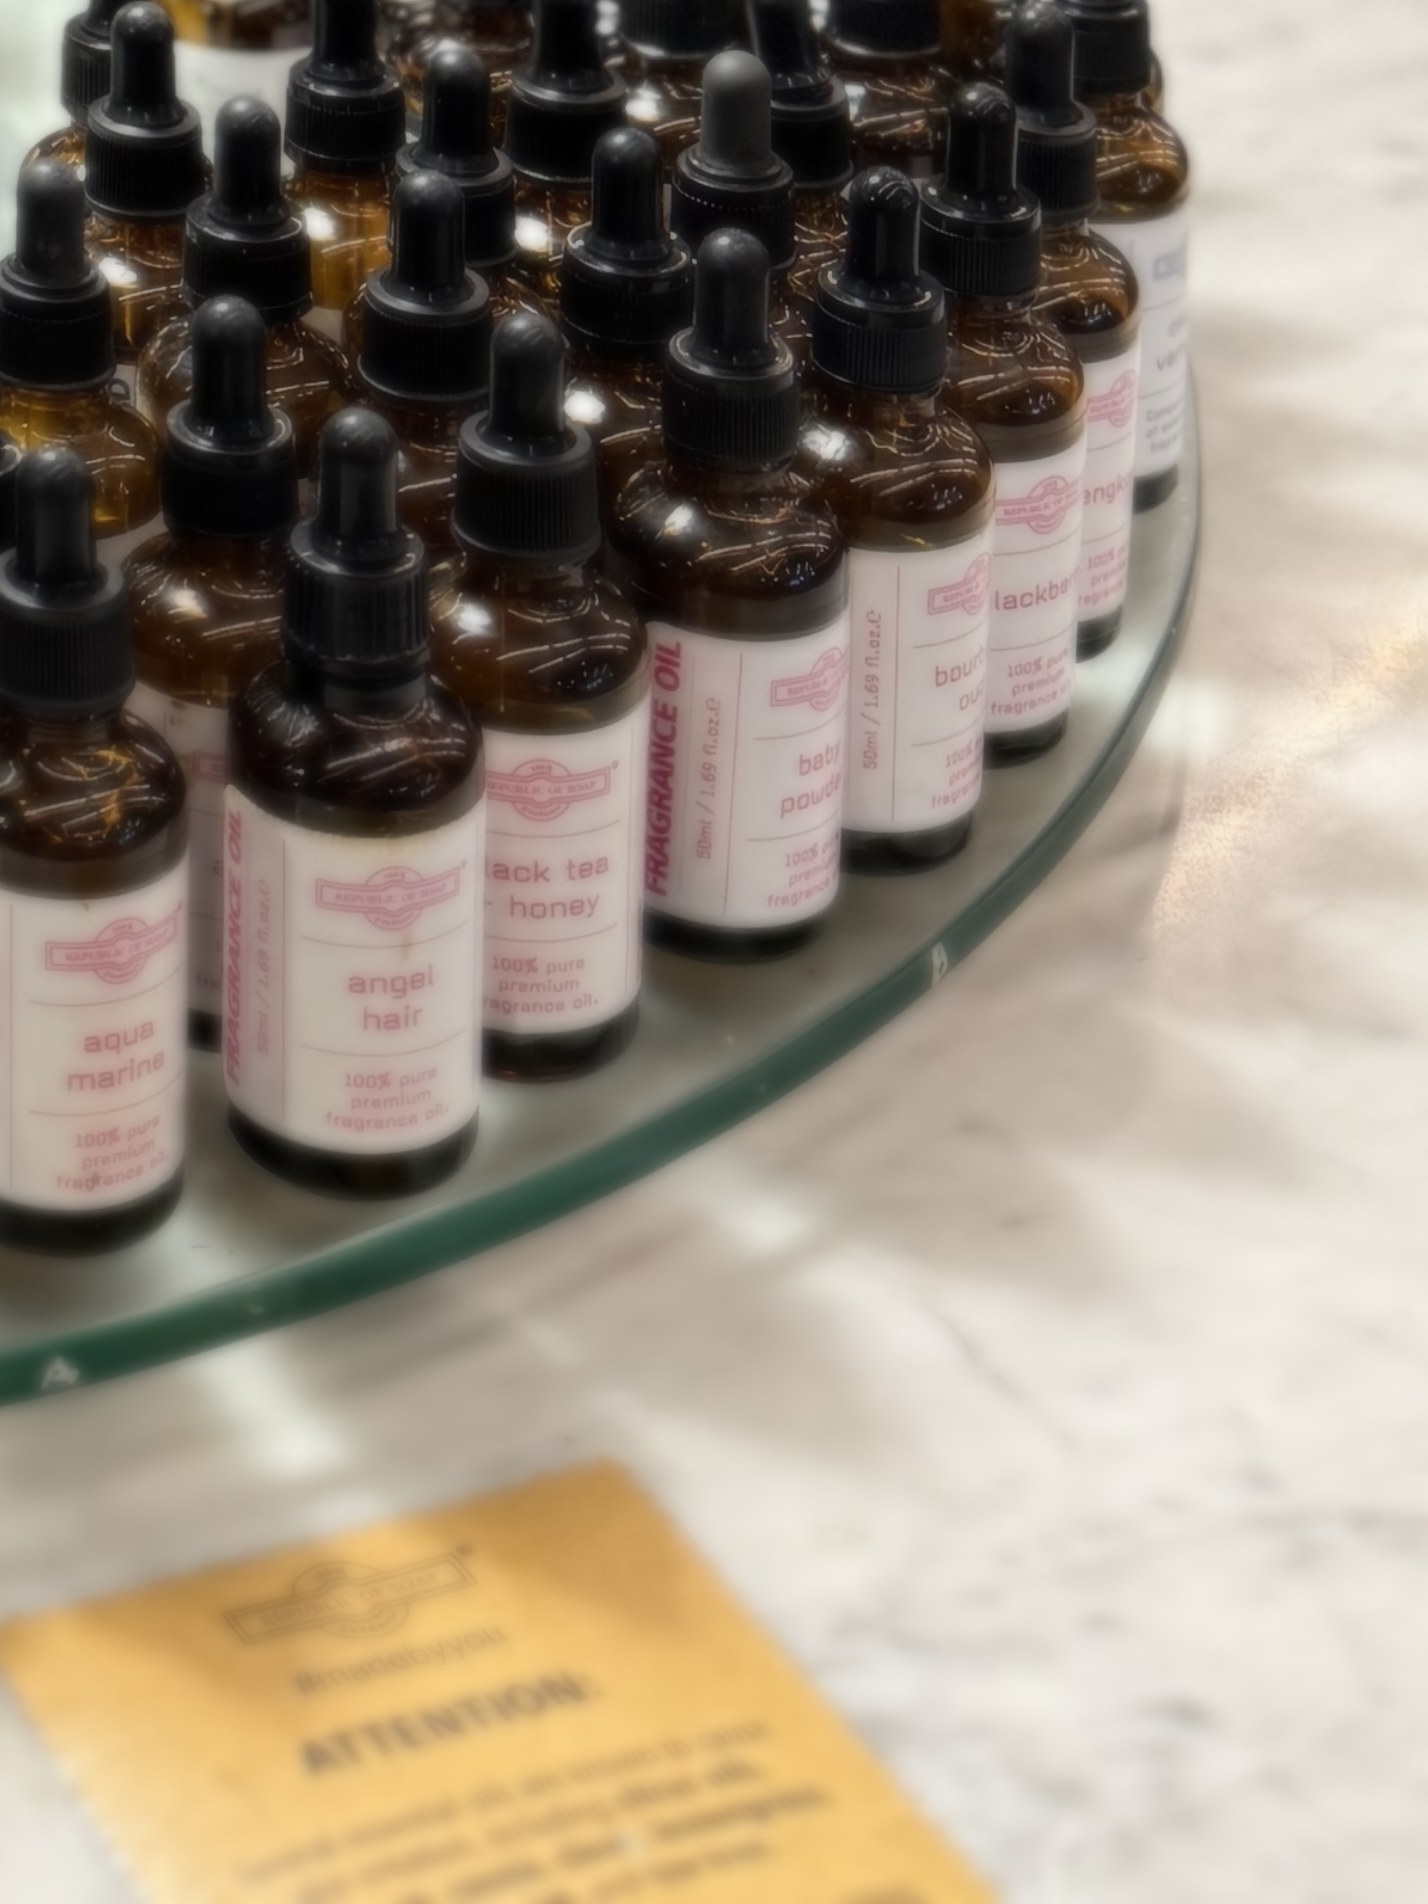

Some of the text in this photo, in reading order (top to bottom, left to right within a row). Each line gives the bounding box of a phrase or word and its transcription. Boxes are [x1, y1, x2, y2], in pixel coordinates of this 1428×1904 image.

[864, 675, 879, 707] 1.69
[863, 732, 878, 769] 50ml
[646, 641, 681, 896] FRAGRANCE OIL
[700, 762, 717, 798] 1.69
[781, 771, 842, 820] powde
[485, 855, 609, 883] lack tea
[509, 893, 600, 920] honey
[225, 810, 243, 1086] FRAGRANCE OIL
[348, 964, 434, 999] angel
[491, 956, 585, 975] 100% pure
[499, 978, 580, 993] premium
[362, 1004, 425, 1032] hair
[485, 996, 565, 1014] agrance
[83, 1019, 155, 1055] aqua
[66, 1051, 164, 1091] marine
[344, 1067, 438, 1089] 100% pure
[350, 1090, 433, 1110] premium
[74, 1128, 120, 1149] 100%
[326, 1111, 418, 1133] fragrance
[81, 1137, 156, 1171] premium
[293, 1623, 506, 1694] #madebyyou
[300, 1670, 604, 1775] ATTENTION:
